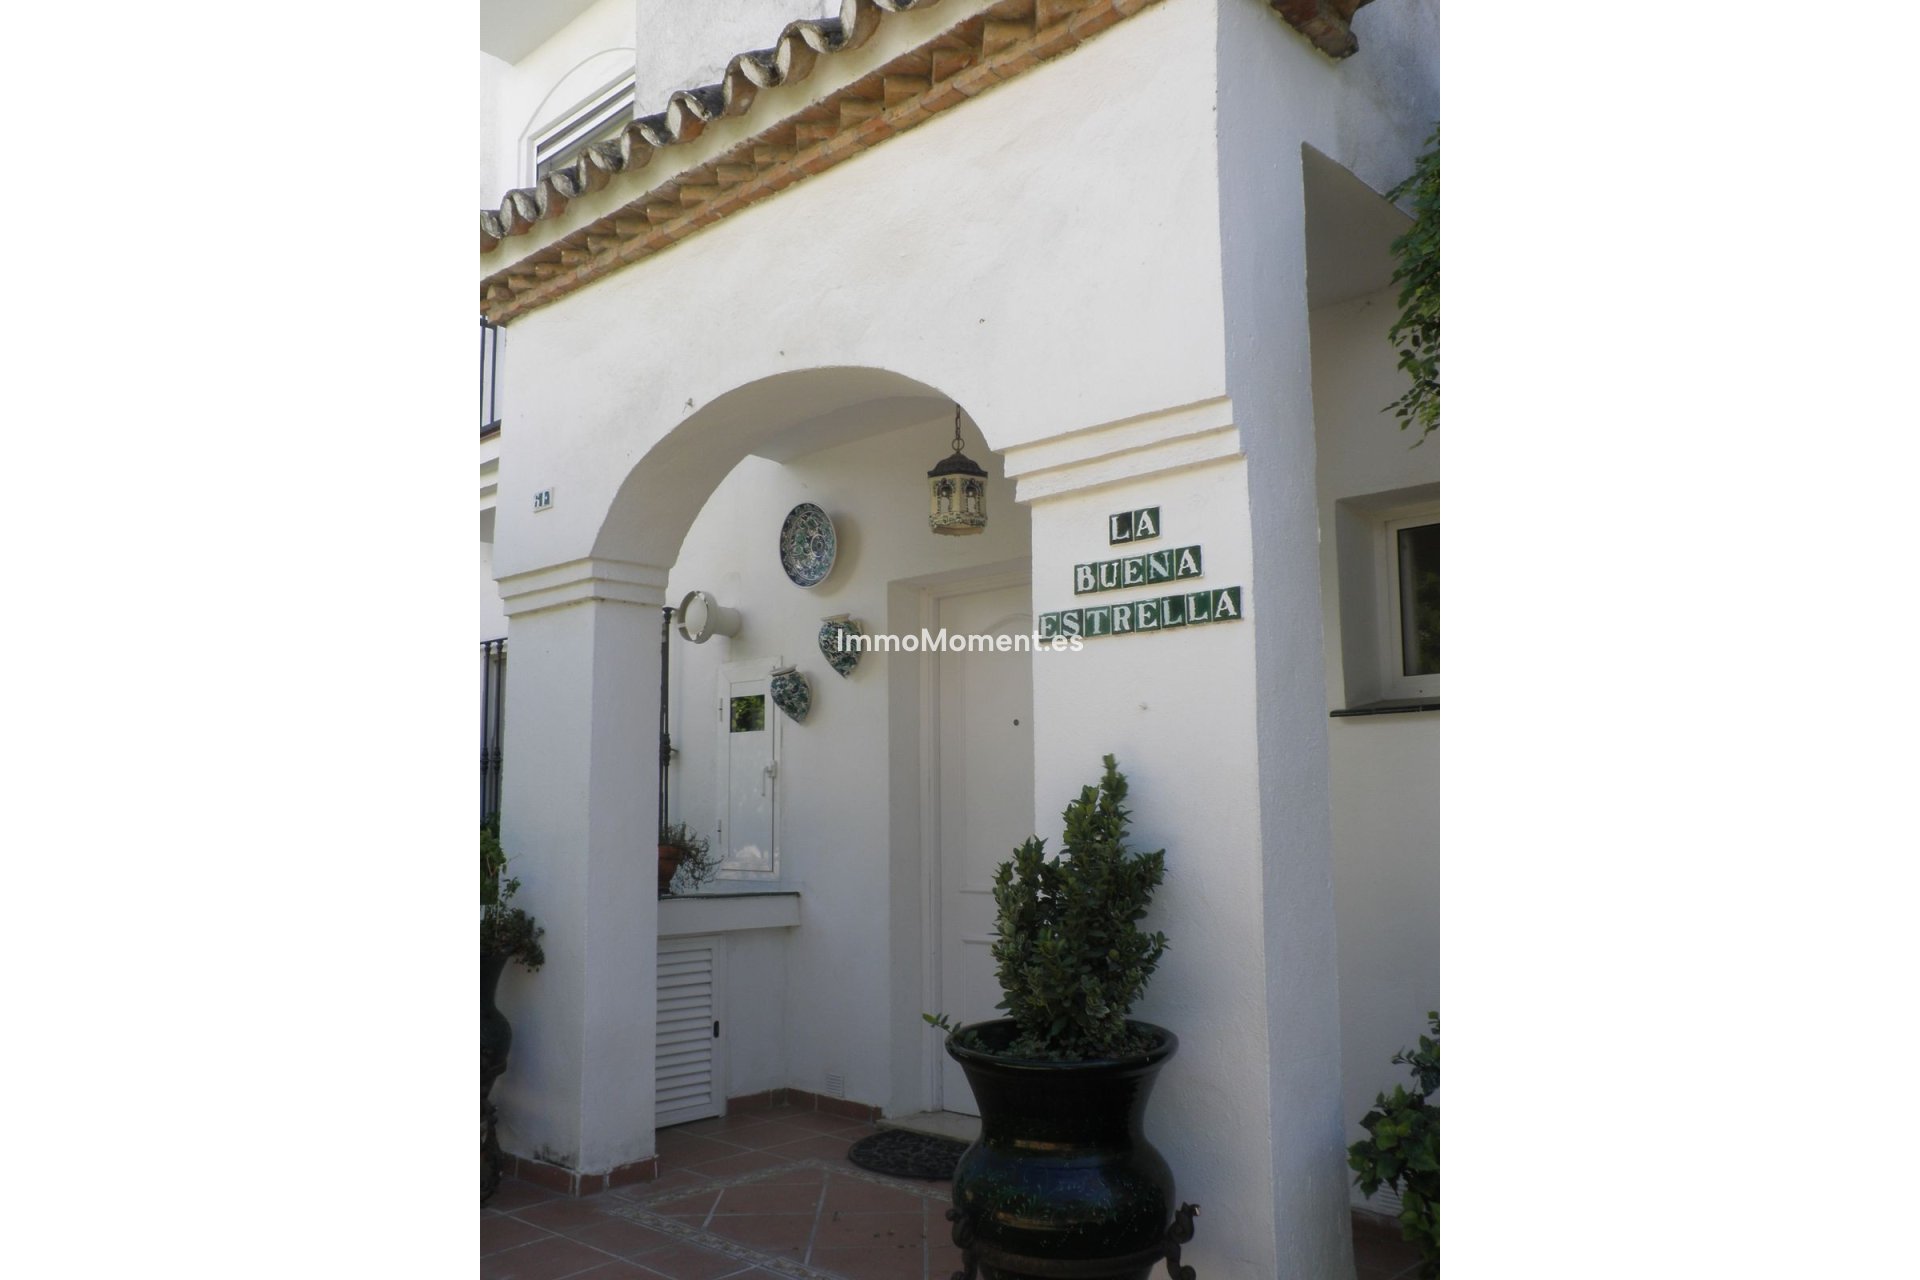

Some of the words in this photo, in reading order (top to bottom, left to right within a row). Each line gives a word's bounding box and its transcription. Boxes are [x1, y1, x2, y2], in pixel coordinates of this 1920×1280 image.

[1110, 509, 1157, 542] LA
[1075, 548, 1200, 593] BUENA
[1039, 589, 1239, 640] ESTRELLA
